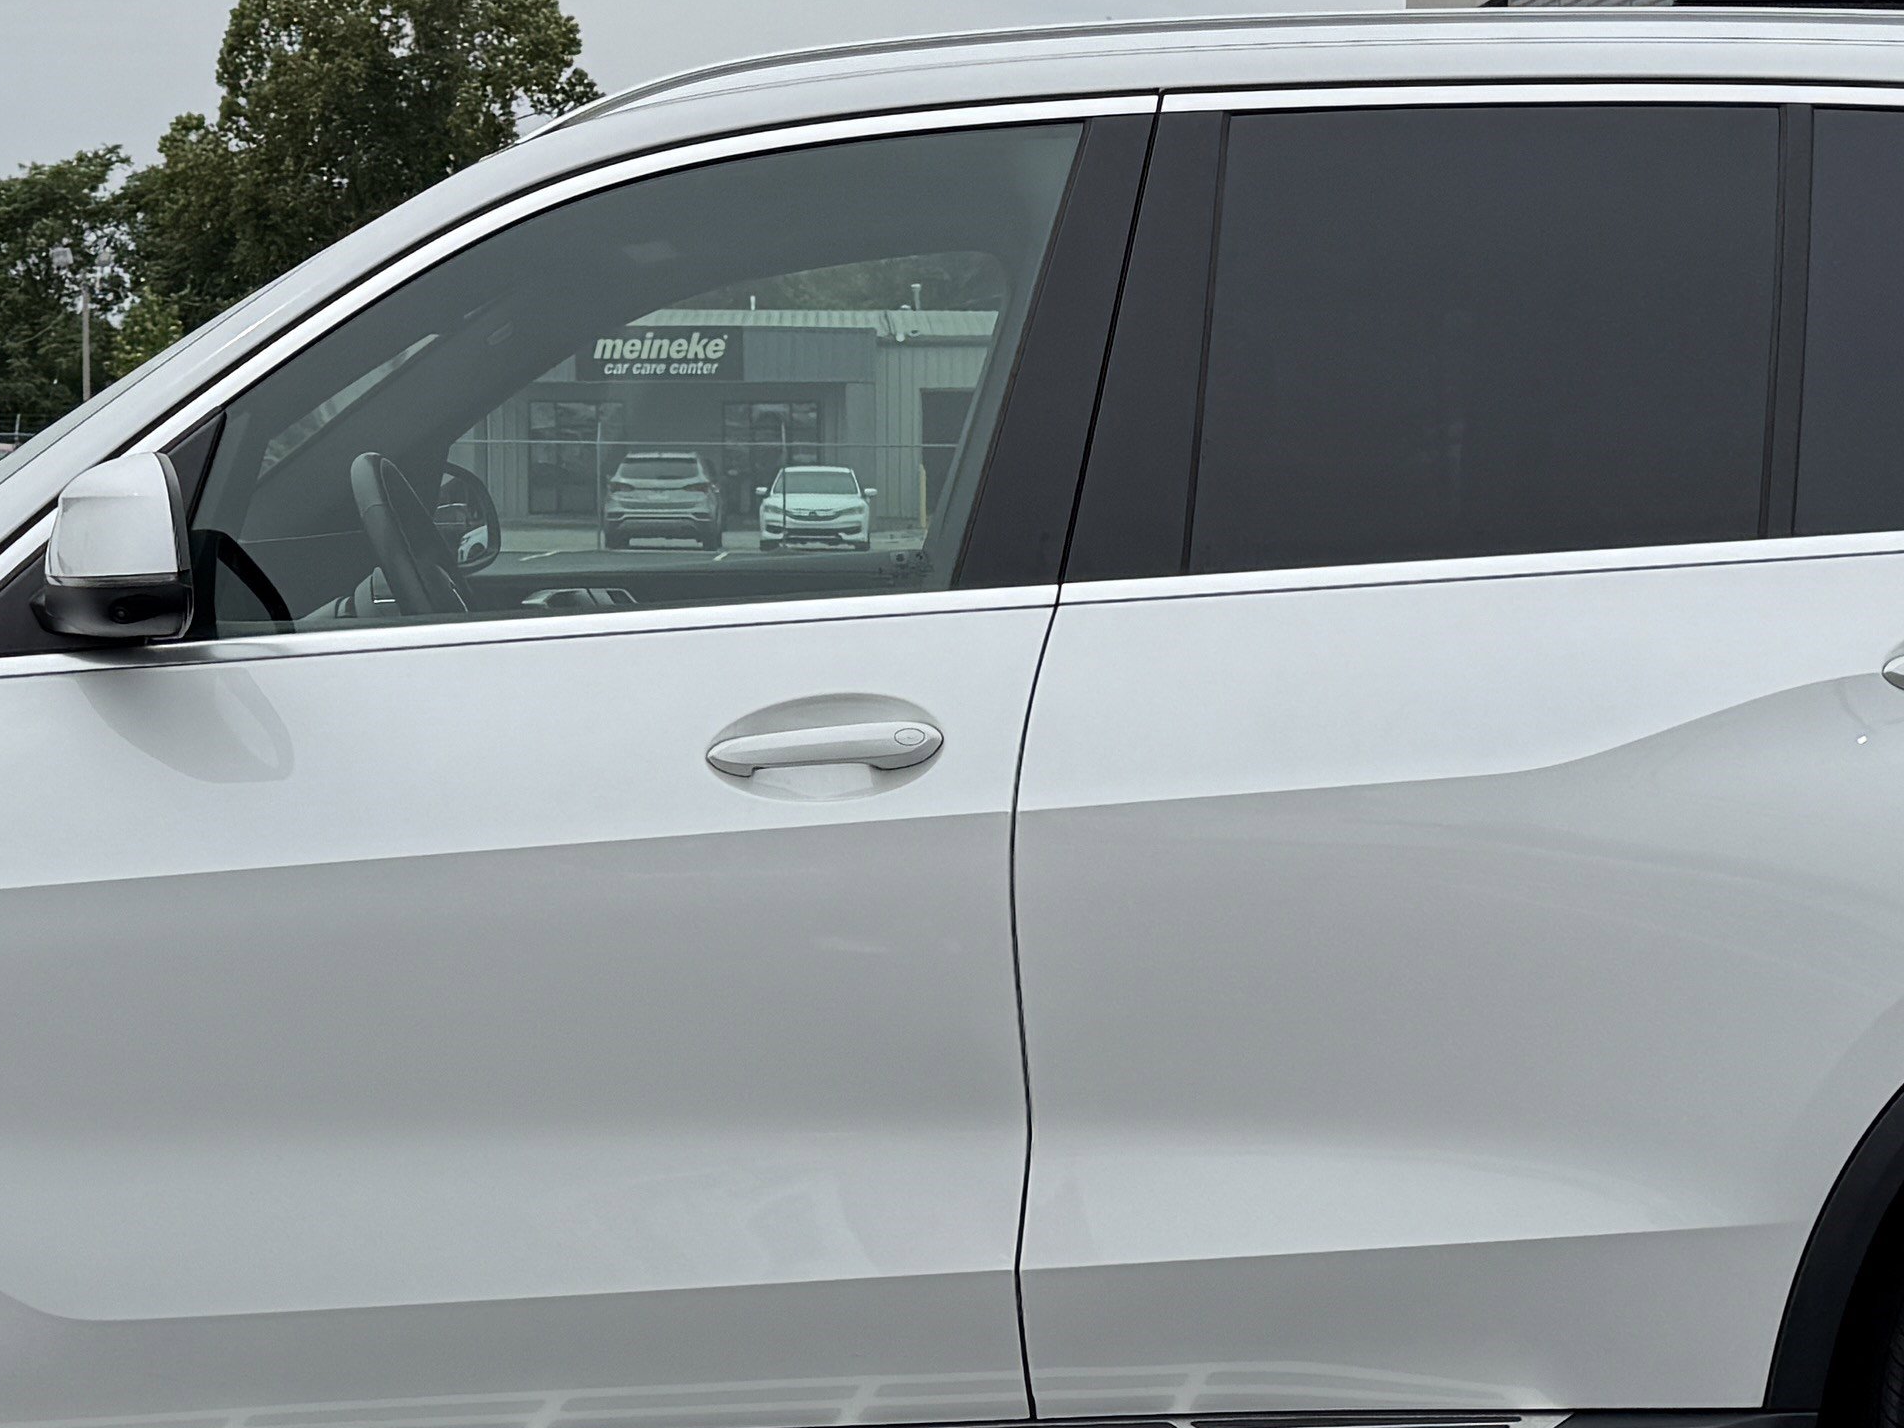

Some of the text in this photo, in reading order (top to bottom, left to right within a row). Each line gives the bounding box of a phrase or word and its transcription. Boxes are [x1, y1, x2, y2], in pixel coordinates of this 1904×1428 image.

[593, 331, 727, 360] meineke
[604, 361, 719, 375] car care center
